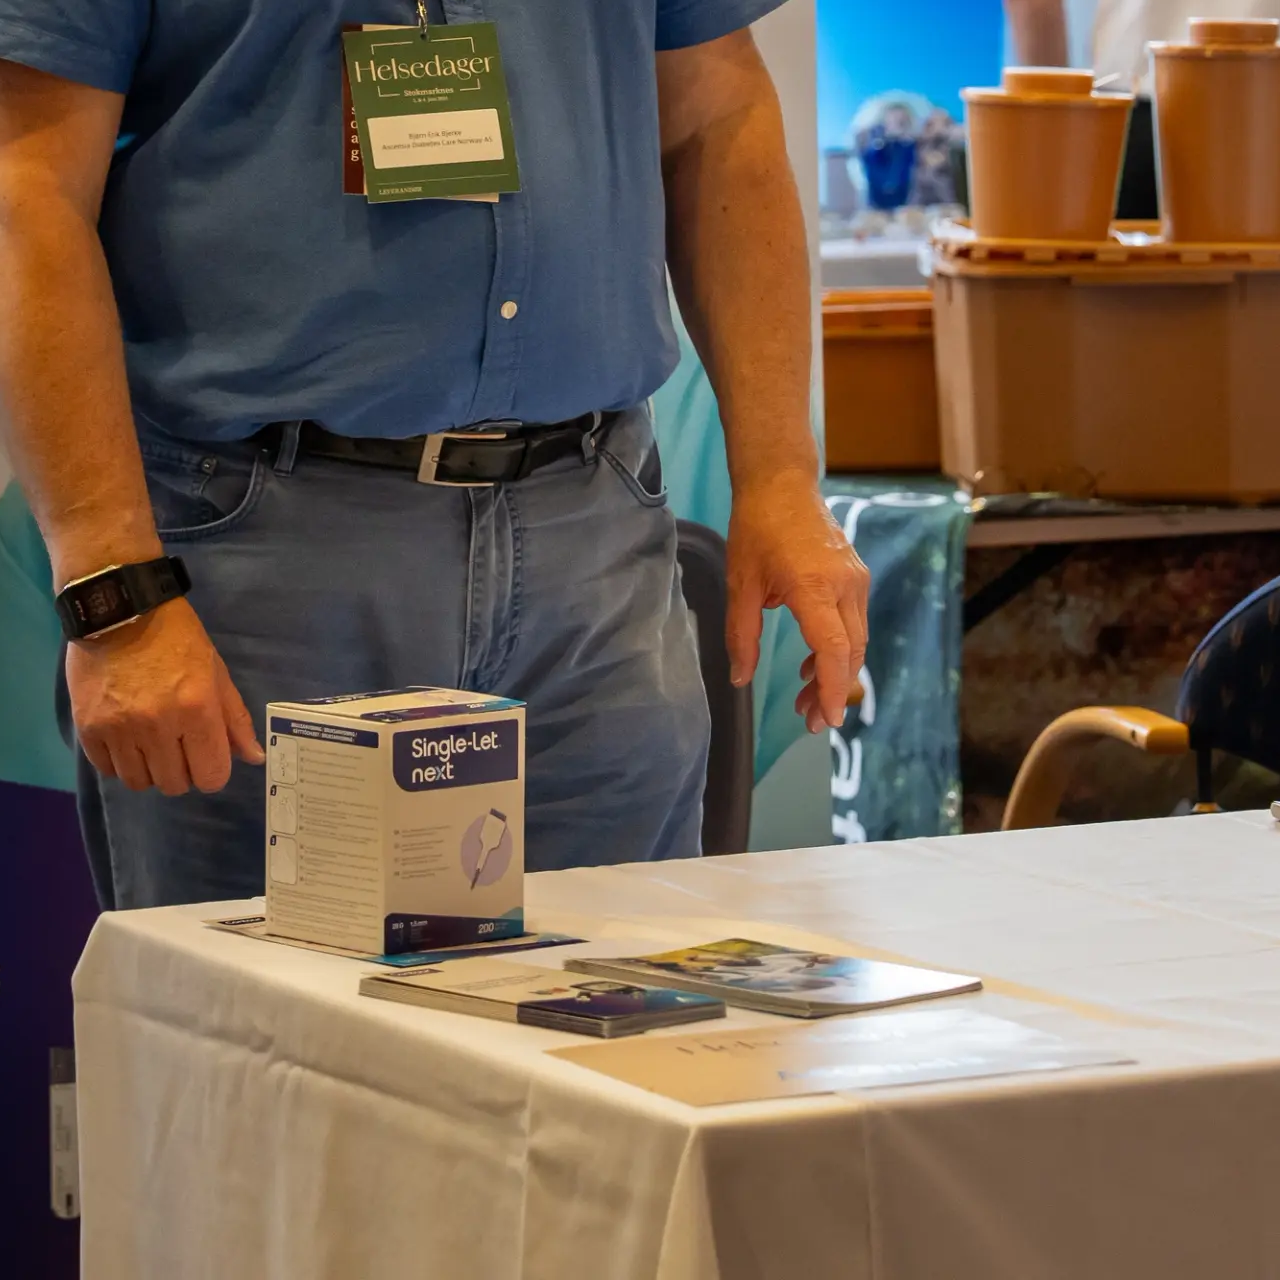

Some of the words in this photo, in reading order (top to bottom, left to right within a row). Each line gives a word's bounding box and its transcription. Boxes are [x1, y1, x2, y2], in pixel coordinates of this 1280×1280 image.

[354, 54, 495, 83] Helsedager
[411, 731, 498, 762] Single-Let
[411, 762, 455, 784] next
[478, 922, 495, 934] 200
